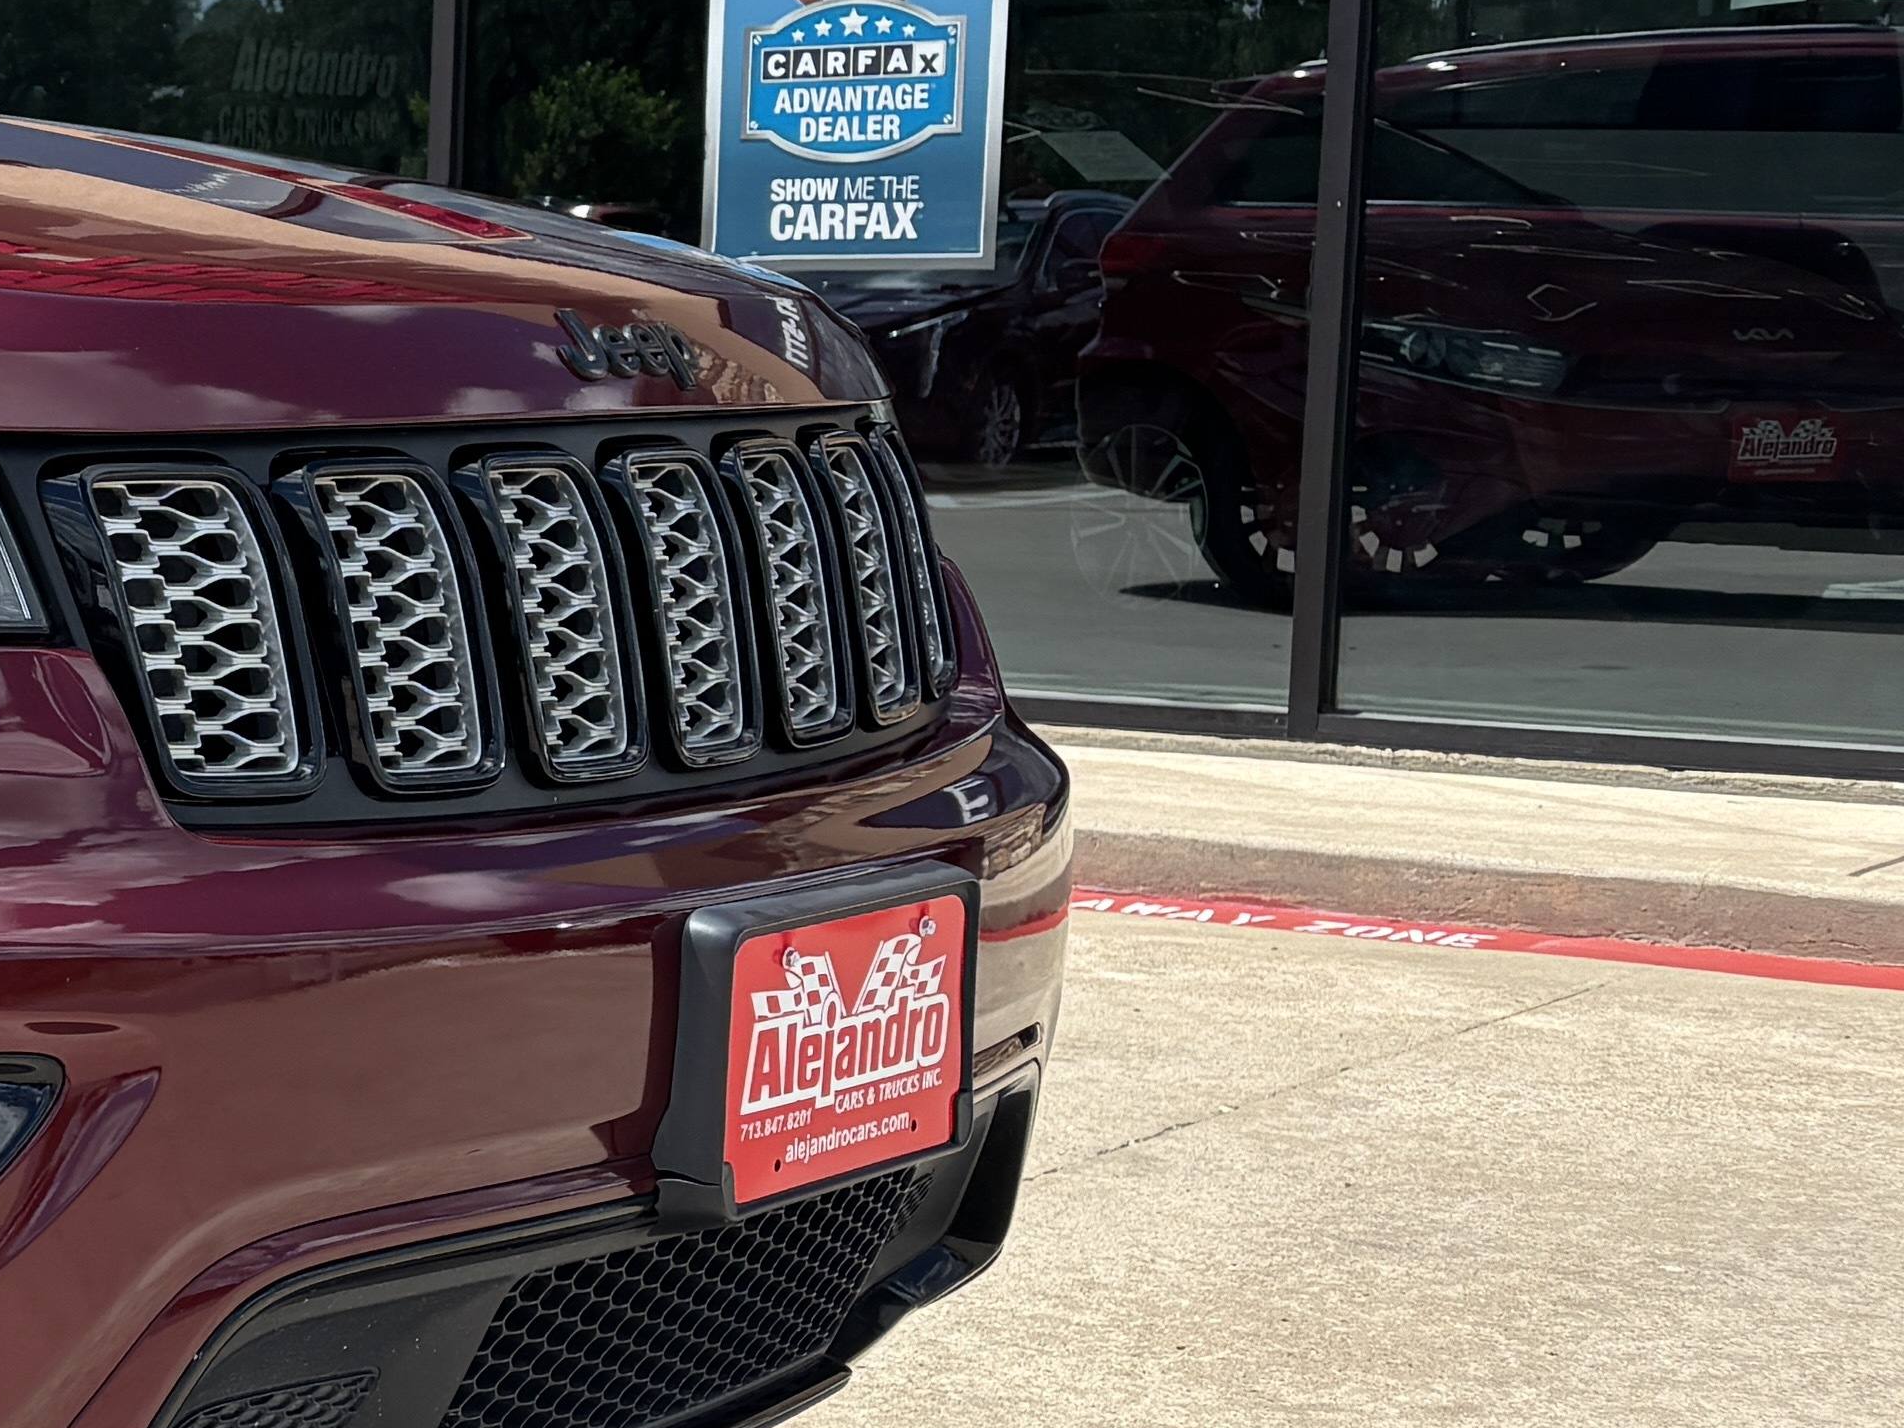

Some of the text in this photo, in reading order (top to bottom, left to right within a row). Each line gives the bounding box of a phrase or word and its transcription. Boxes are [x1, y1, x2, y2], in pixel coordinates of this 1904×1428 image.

[766, 46, 942, 79] CARFAX
[775, 84, 929, 113] ADVANTAGE
[799, 115, 901, 143] DEALER
[771, 175, 919, 203] SHOW ME THE
[770, 202, 919, 241] CARFAX
[553, 308, 698, 392] Jeep
[1738, 435, 1837, 460] Alejandro
[1294, 920, 1499, 949] ZONE
[748, 994, 948, 1107] Alejandro
[835, 1068, 943, 1114] CARS & TRUCKS INC.
[740, 1107, 812, 1141] 713.847.8201
[785, 1110, 910, 1165] alejandrocars.com
